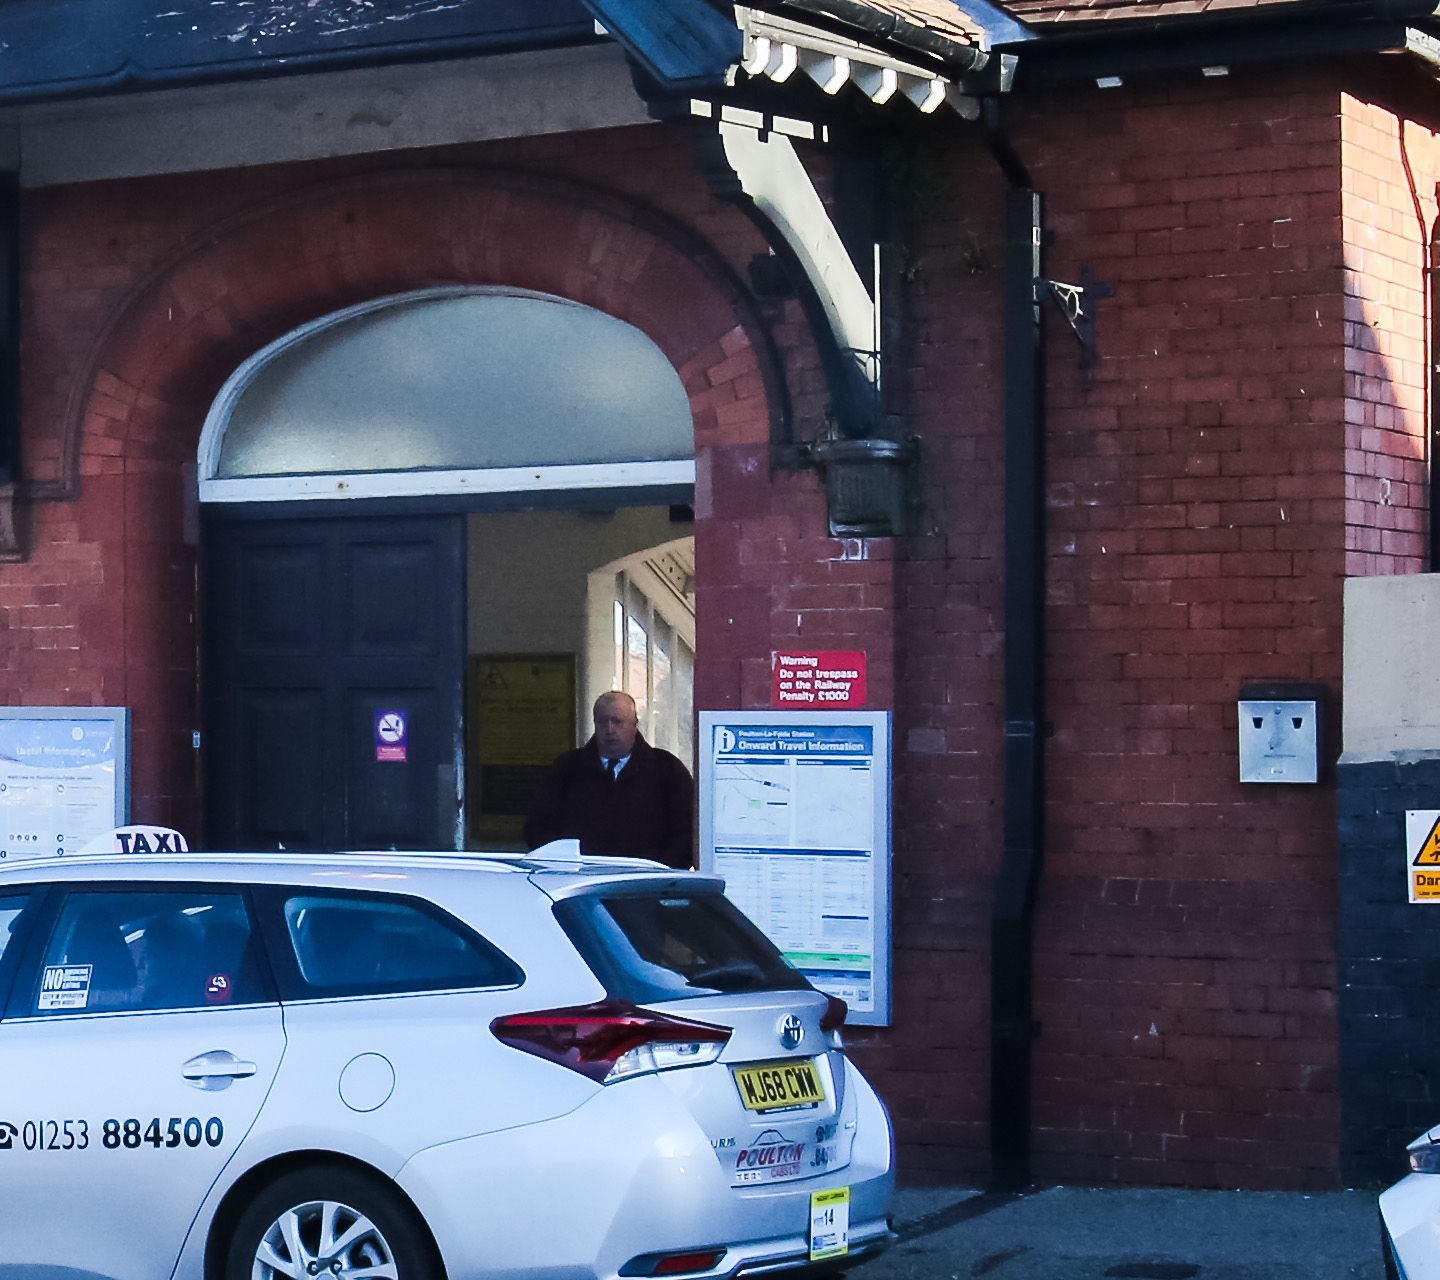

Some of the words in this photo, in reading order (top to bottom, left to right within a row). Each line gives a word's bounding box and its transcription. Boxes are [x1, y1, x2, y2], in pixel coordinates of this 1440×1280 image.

[779, 655, 818, 667] Warning
[779, 670, 794, 679] Do
[796, 670, 813, 679] not
[815, 670, 859, 680] trespass
[779, 682, 793, 690] on
[795, 681, 811, 690] the
[814, 681, 852, 691] Railway
[779, 691, 815, 702] Penalty
[818, 691, 849, 701] £1000
[738, 740, 777, 751] Onward
[778, 740, 807, 751] Travel
[808, 741, 864, 751] Information
[116, 833, 184, 854] TAXI
[43, 968, 64, 990] NO
[741, 1070, 787, 1104] MJ68
[22, 1118, 89, 1152] 01253
[101, 1116, 224, 1150] 884500
[736, 1142, 806, 1169] POULTON
[824, 1208, 834, 1226] 14
